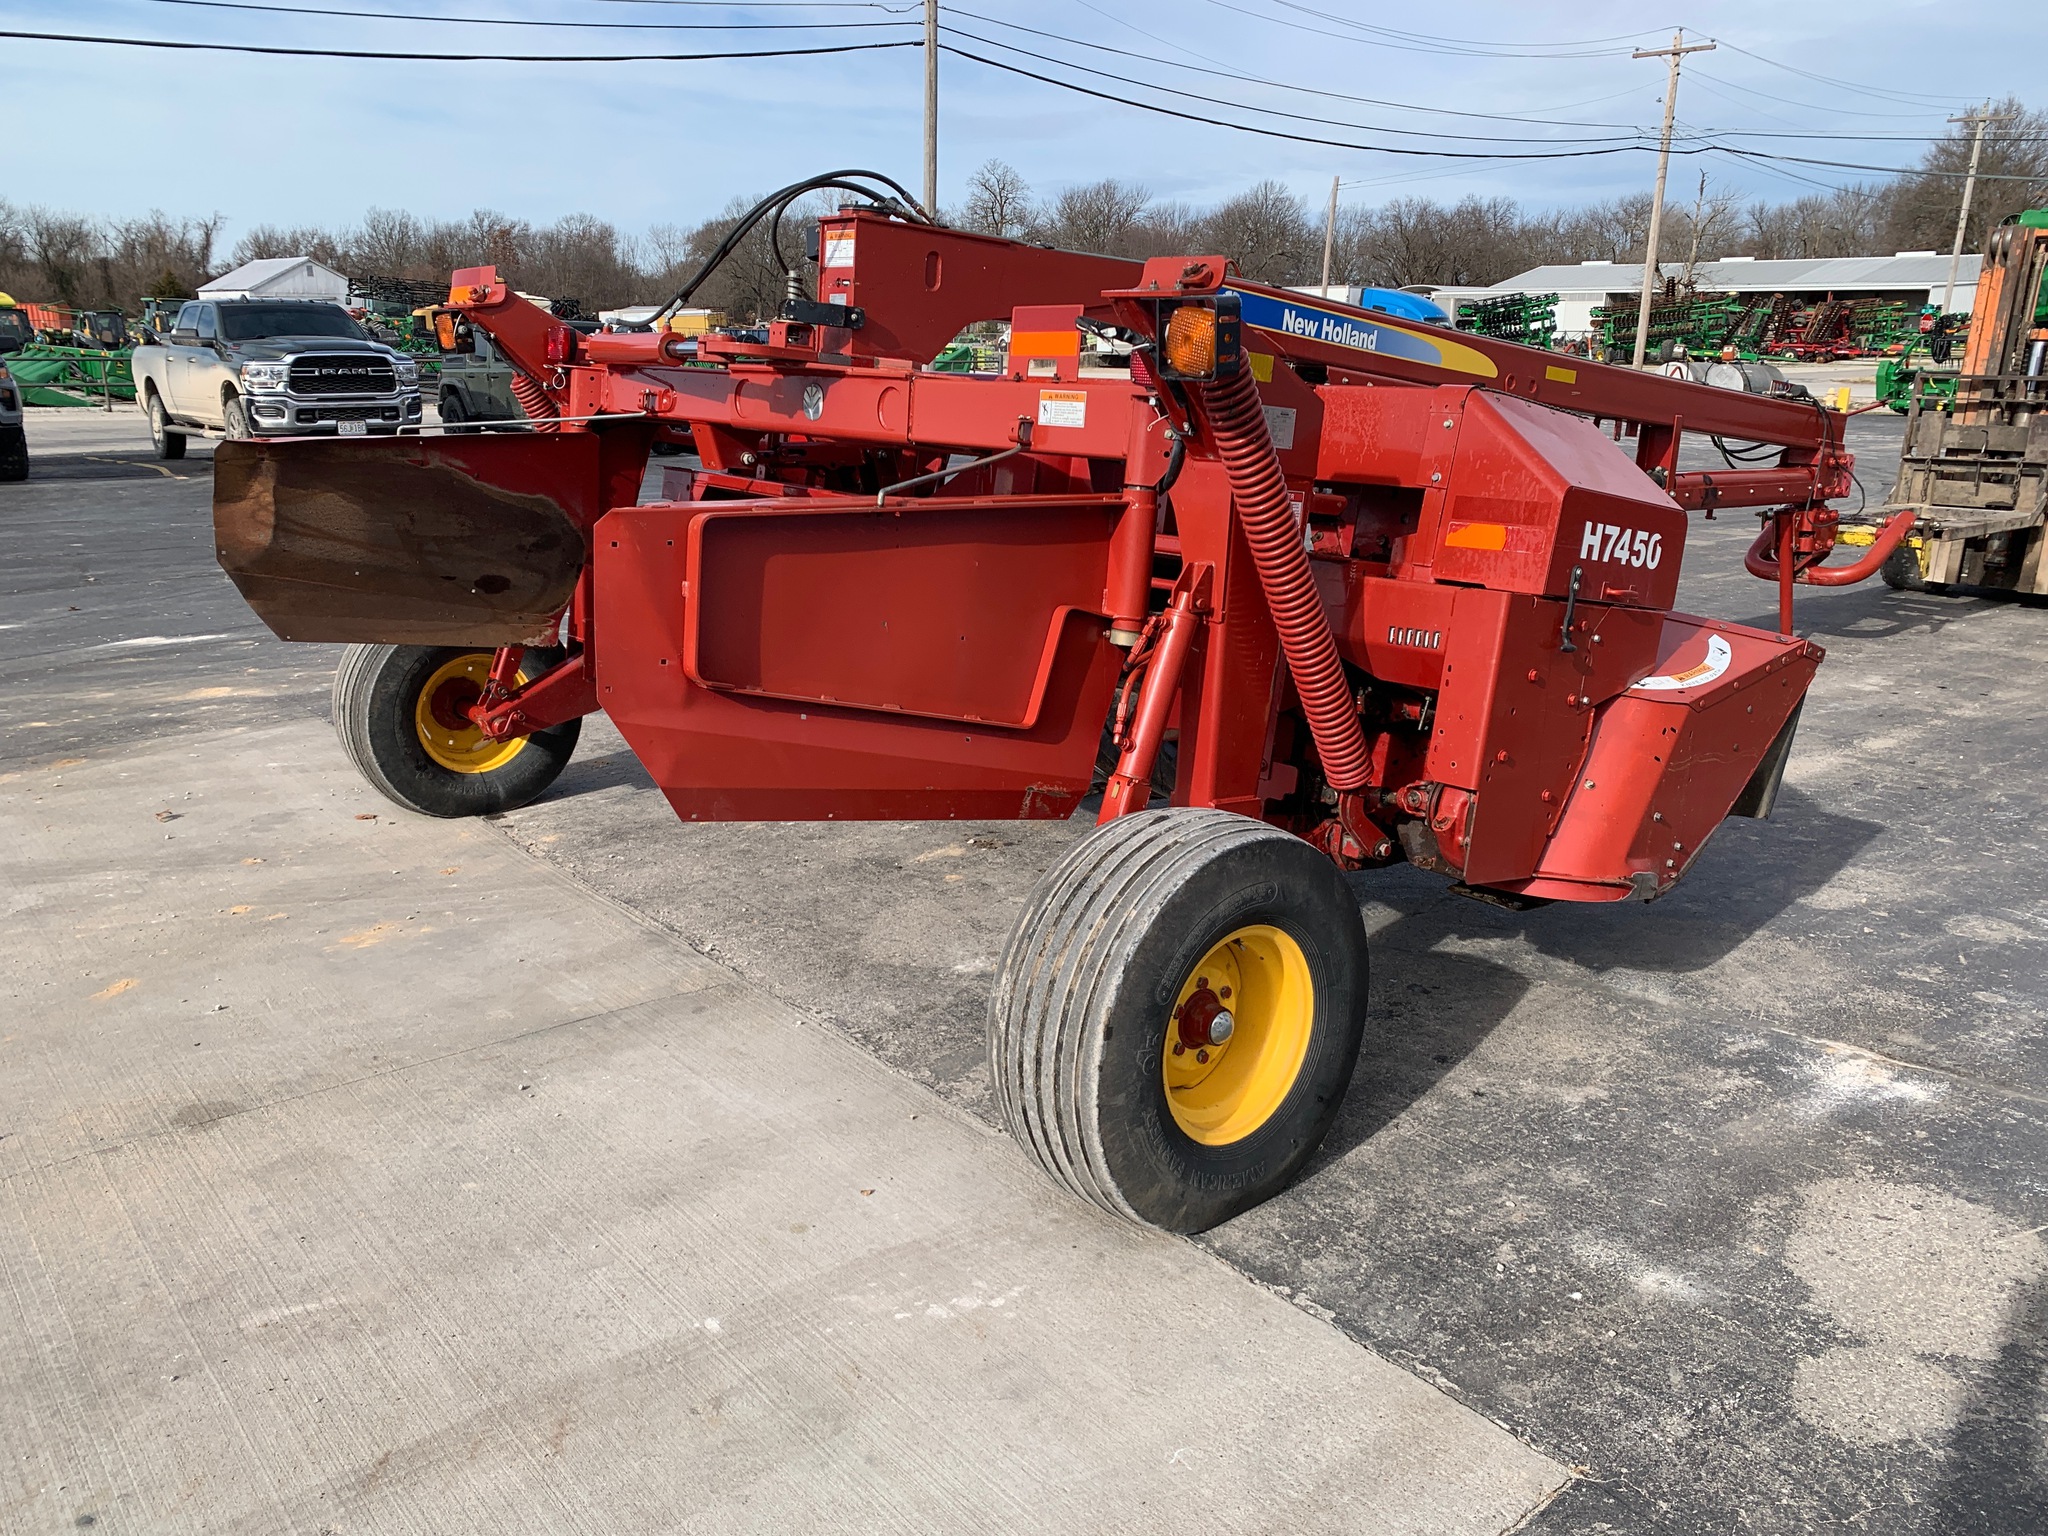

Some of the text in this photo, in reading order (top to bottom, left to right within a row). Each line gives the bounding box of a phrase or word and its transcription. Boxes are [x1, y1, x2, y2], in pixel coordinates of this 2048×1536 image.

[1281, 308, 1378, 351] New Holland
[1580, 520, 1663, 570] H7450
[1141, 1108, 1266, 1192] AMERICAN FARMER
